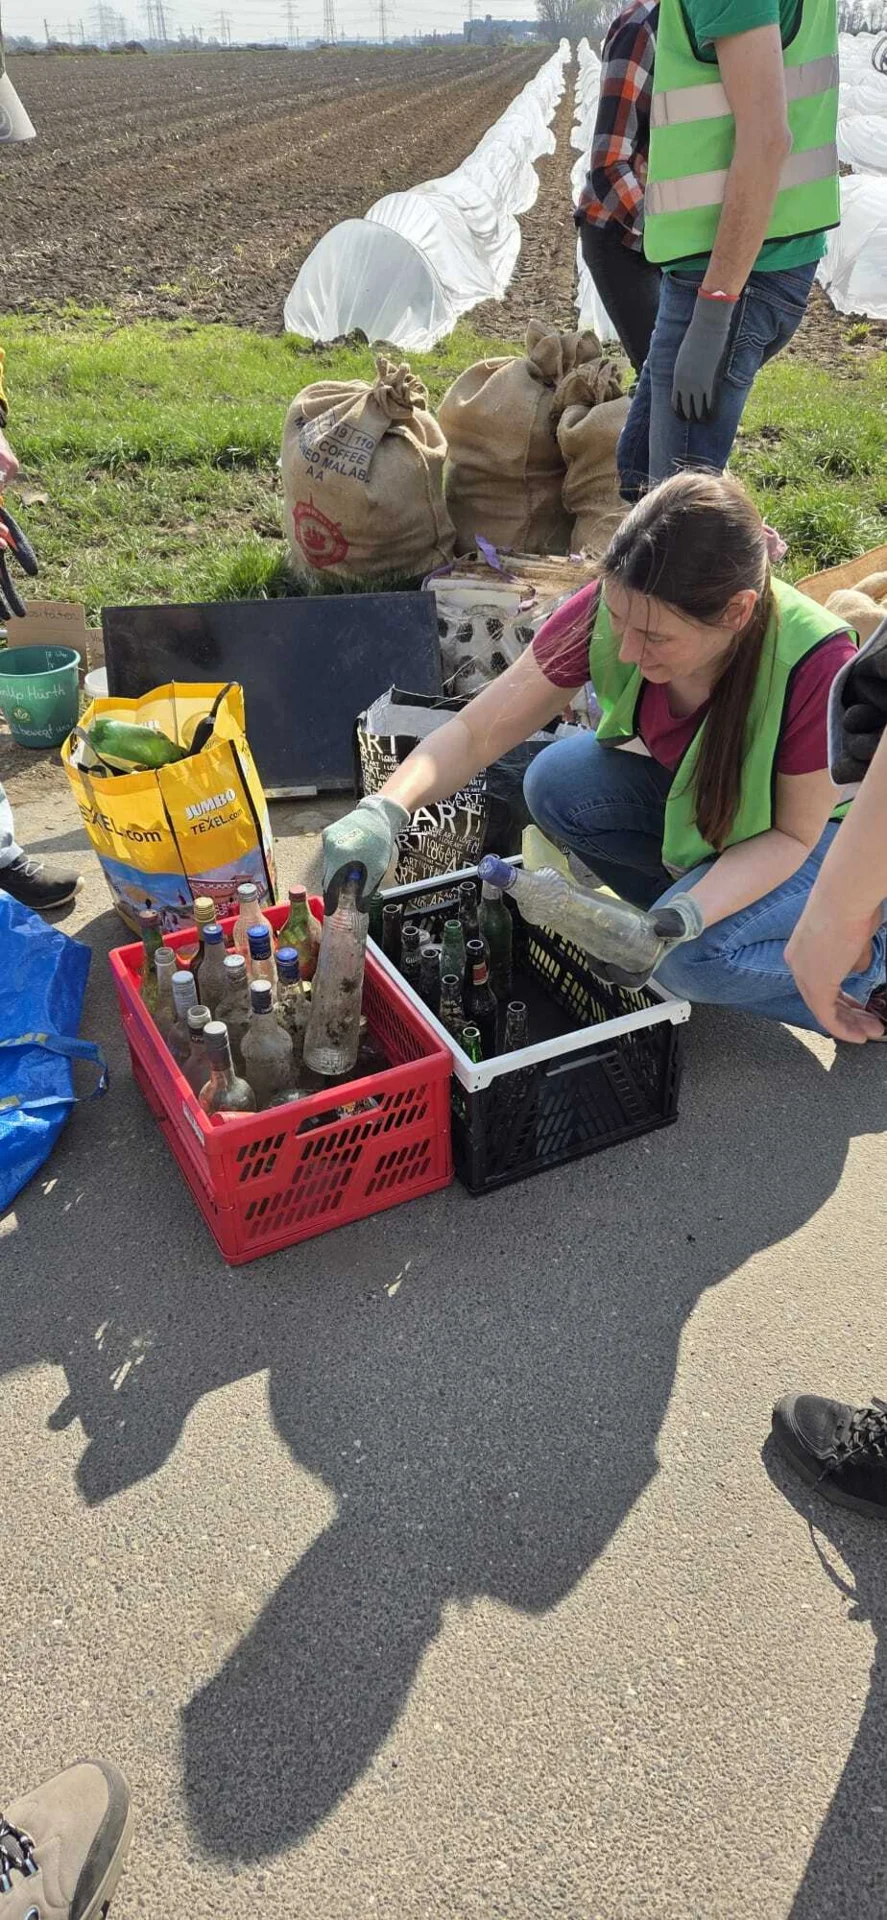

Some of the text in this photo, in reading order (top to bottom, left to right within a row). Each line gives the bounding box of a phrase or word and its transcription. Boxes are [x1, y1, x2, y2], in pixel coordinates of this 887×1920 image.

[319, 440, 368, 465] COFFEE
[354, 436, 374, 450] 110
[321, 457, 371, 484] MALAB
[184, 788, 236, 821] JUMBO
[455, 792, 482, 804] ART
[190, 808, 243, 836] TEXEL.com
[411, 802, 482, 838] ART
[402, 856, 418, 868] ART
[445, 846, 463, 861] ART
